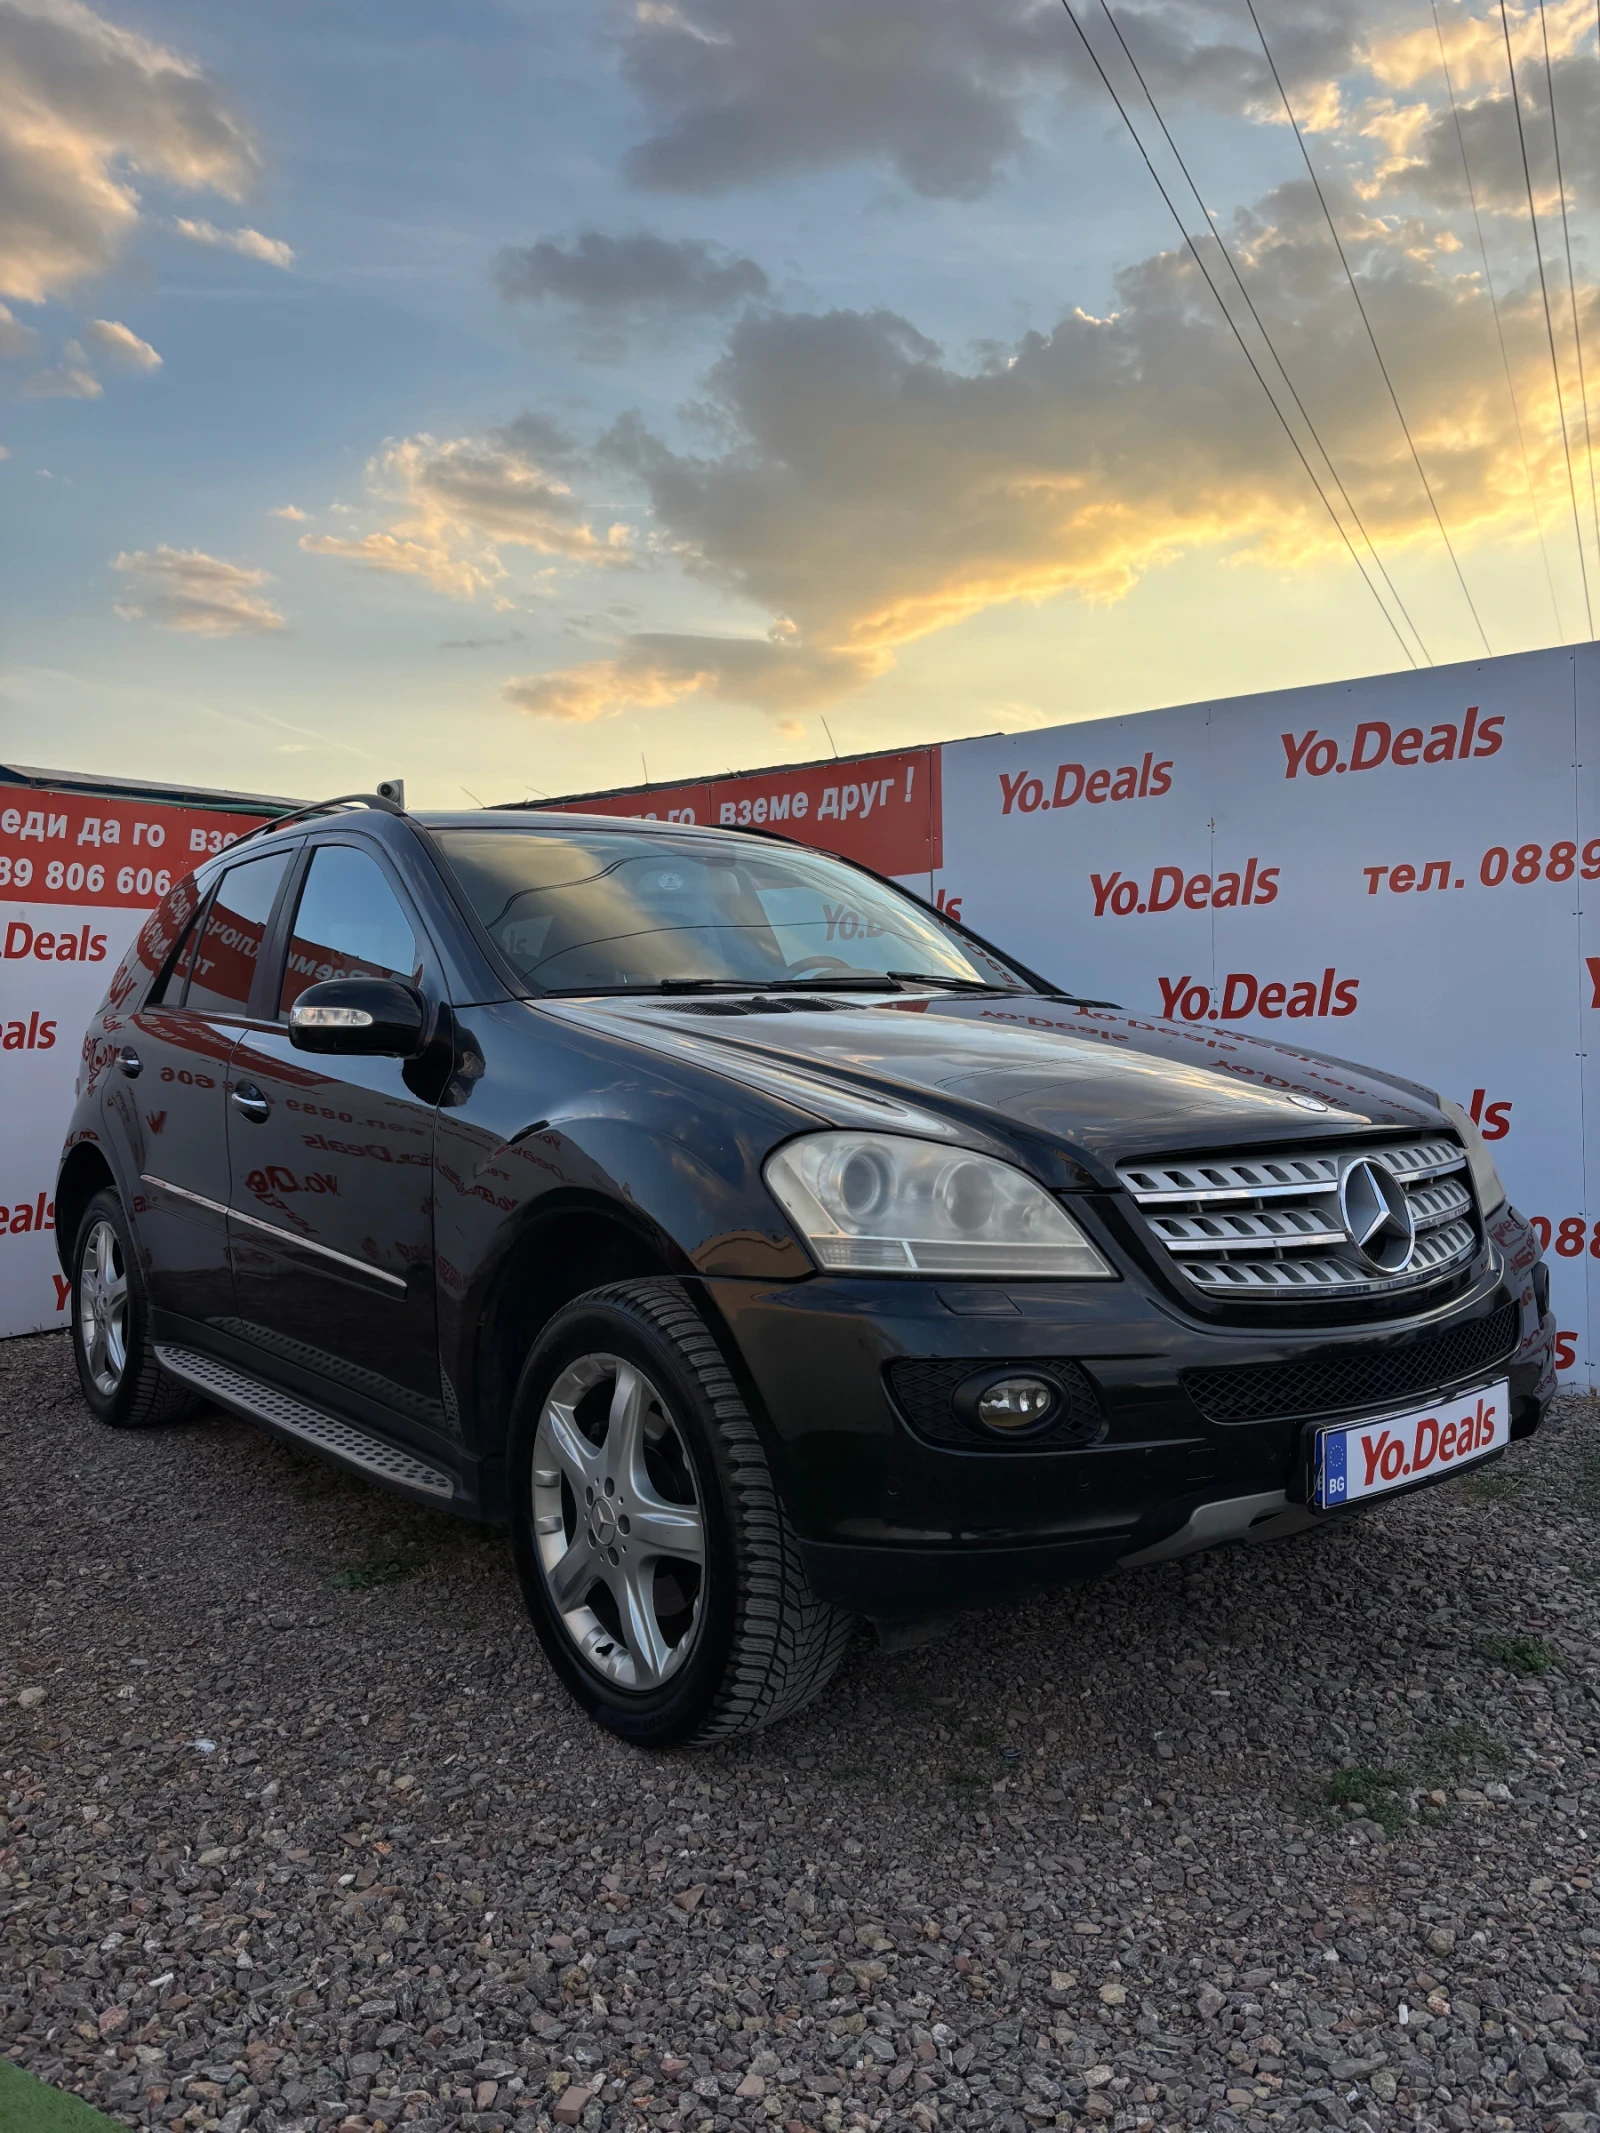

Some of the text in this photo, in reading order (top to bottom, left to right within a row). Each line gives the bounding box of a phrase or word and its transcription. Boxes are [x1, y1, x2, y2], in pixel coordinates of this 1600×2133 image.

[1281, 707, 1505, 778] Yo.Deals
[719, 791, 809, 827] вземе
[816, 778, 896, 821] друг
[904, 766, 915, 803] !
[999, 752, 1173, 815] Yo.Deals
[76, 817, 121, 848] да
[132, 822, 166, 848] го
[45, 860, 105, 893] 806
[116, 866, 171, 897] 606
[1090, 858, 1280, 917] Yo.Deals
[1363, 838, 1600, 895] тел. 0889
[0, 922, 108, 962] Deals
[1158, 968, 1360, 1021] Yo.Deals
[0, 1011, 57, 1050] als
[1361, 1398, 1496, 1486] Yo.Deals
[1329, 1475, 1345, 1494] BG
